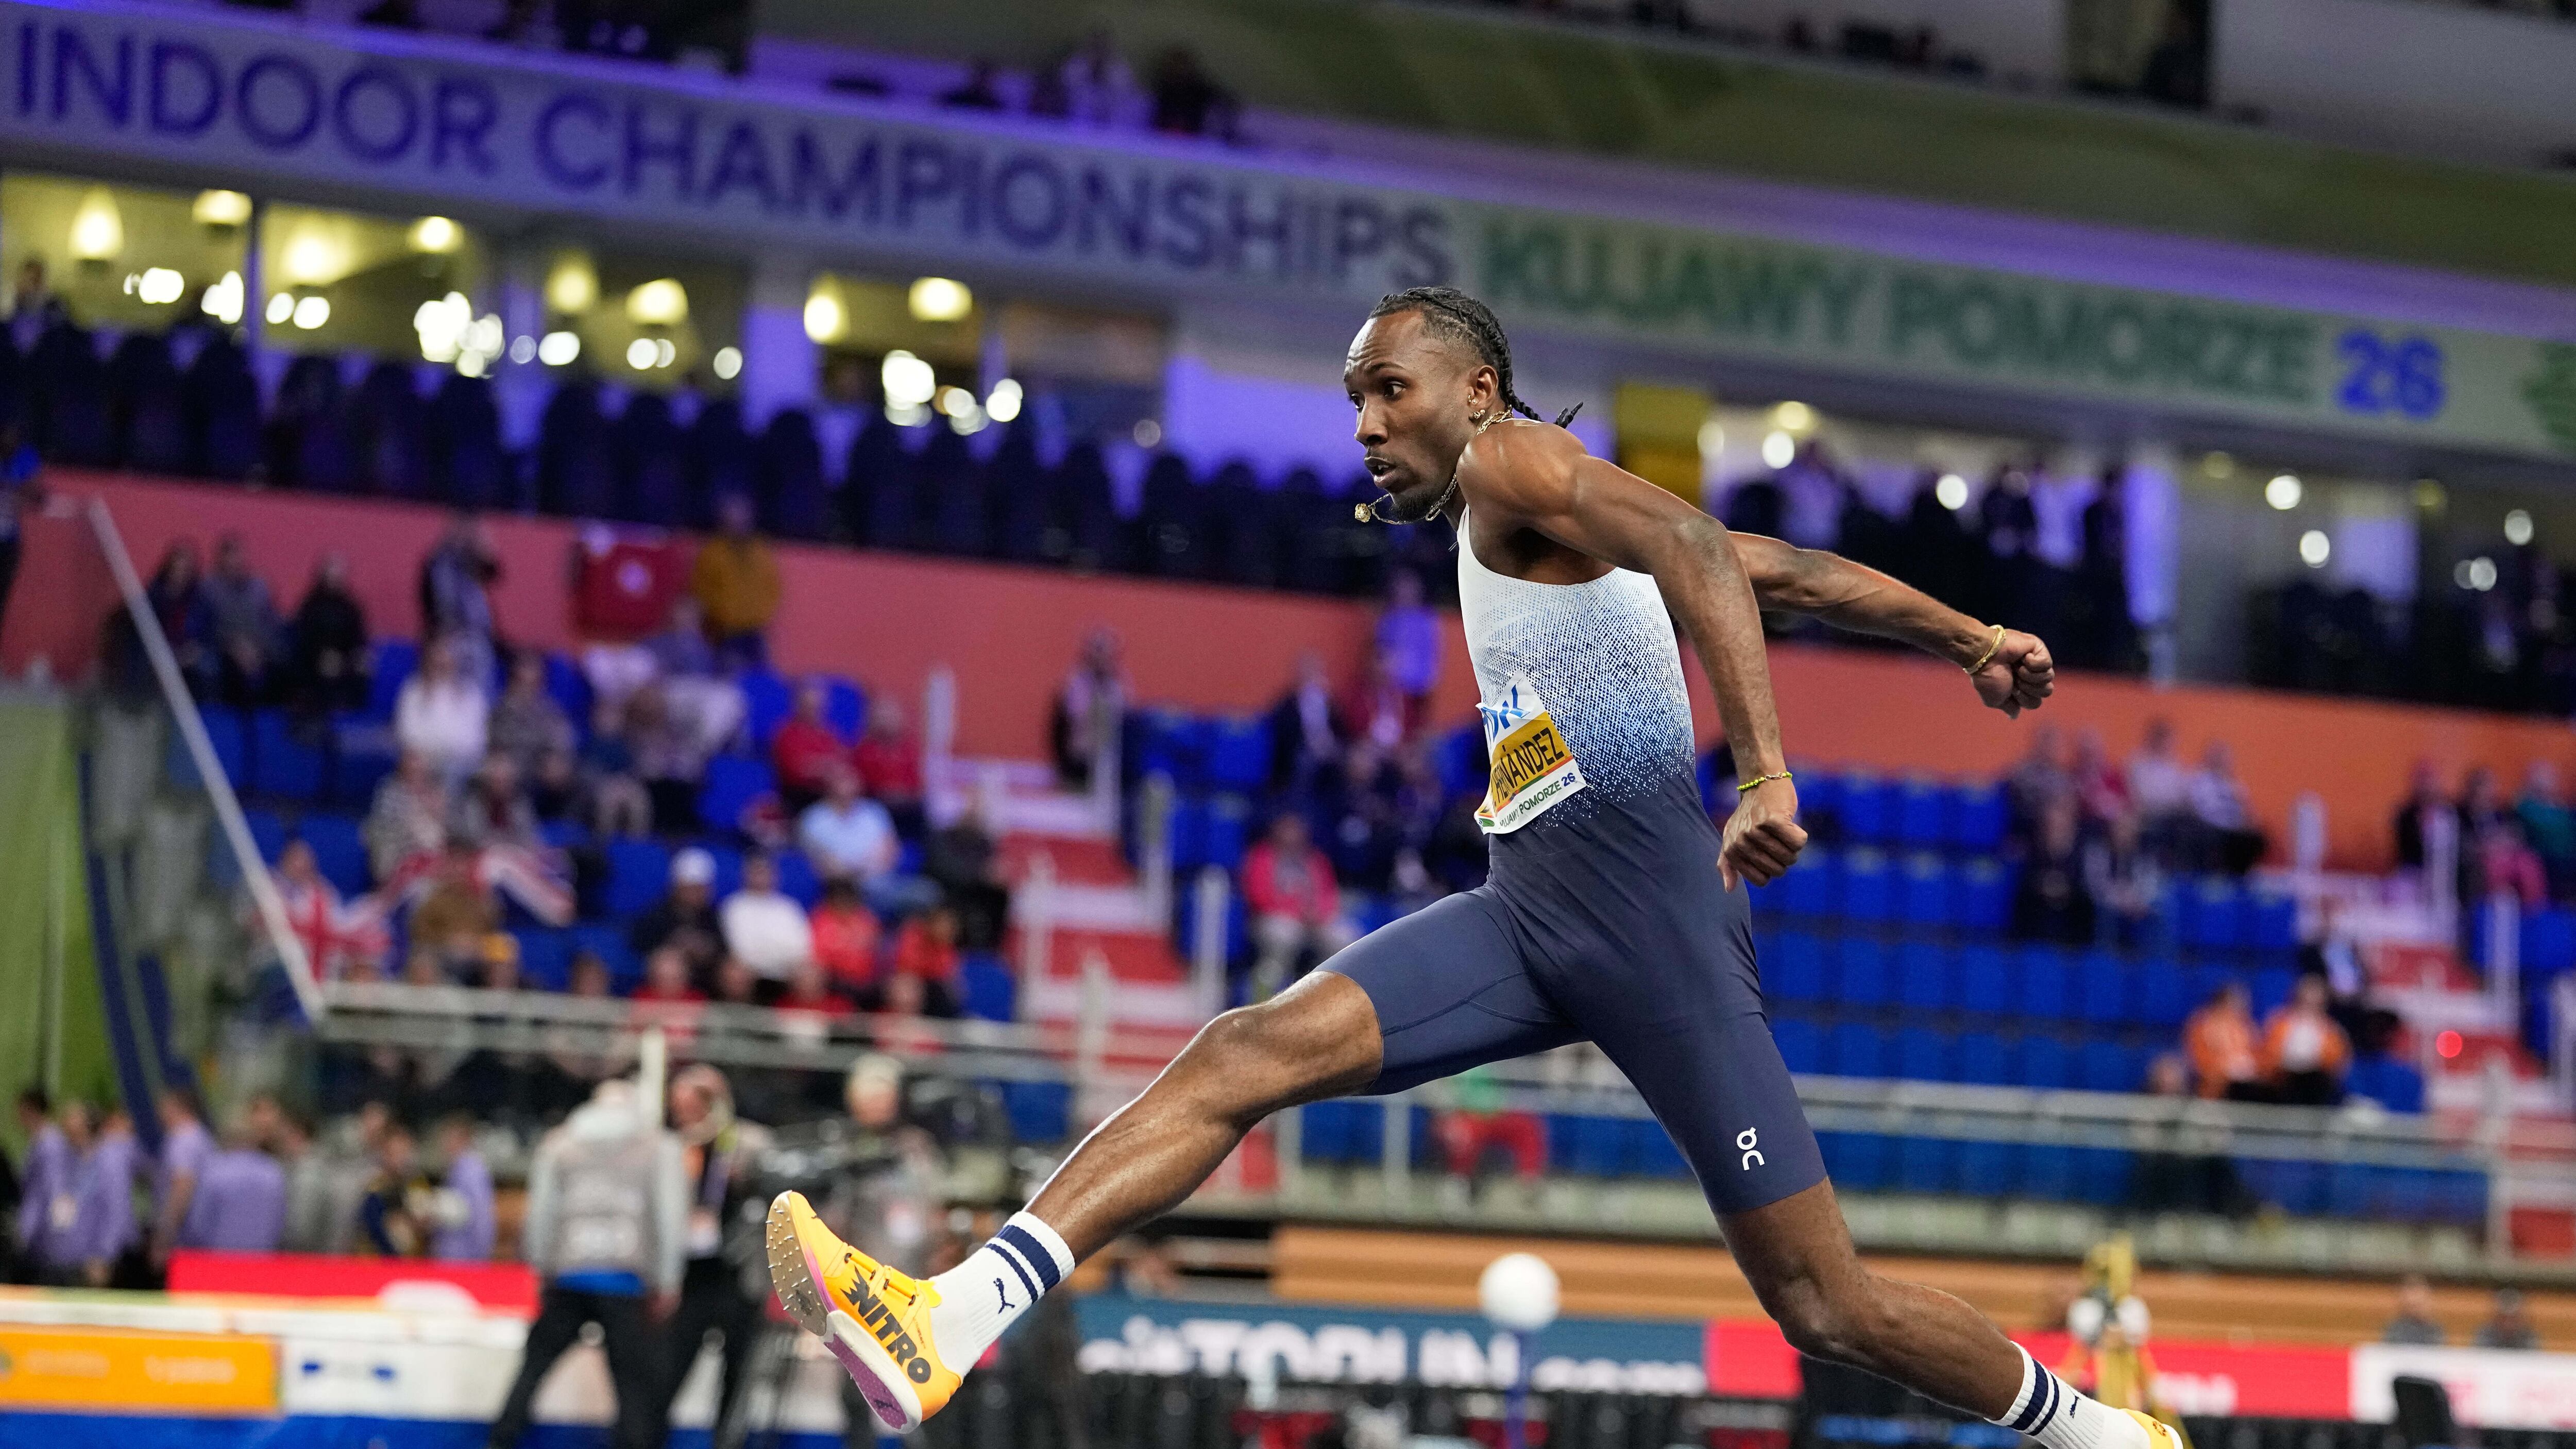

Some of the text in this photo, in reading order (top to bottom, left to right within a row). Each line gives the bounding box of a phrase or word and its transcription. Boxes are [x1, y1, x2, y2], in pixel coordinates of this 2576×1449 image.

[15, 22, 2446, 421] INDOOR CHAMPIONSHIPS KUJAWY POMORZE 26
[1518, 780, 1563, 814] POMORZE
[1561, 772, 1576, 787] 26
[840, 1266, 931, 1384] NITRO
